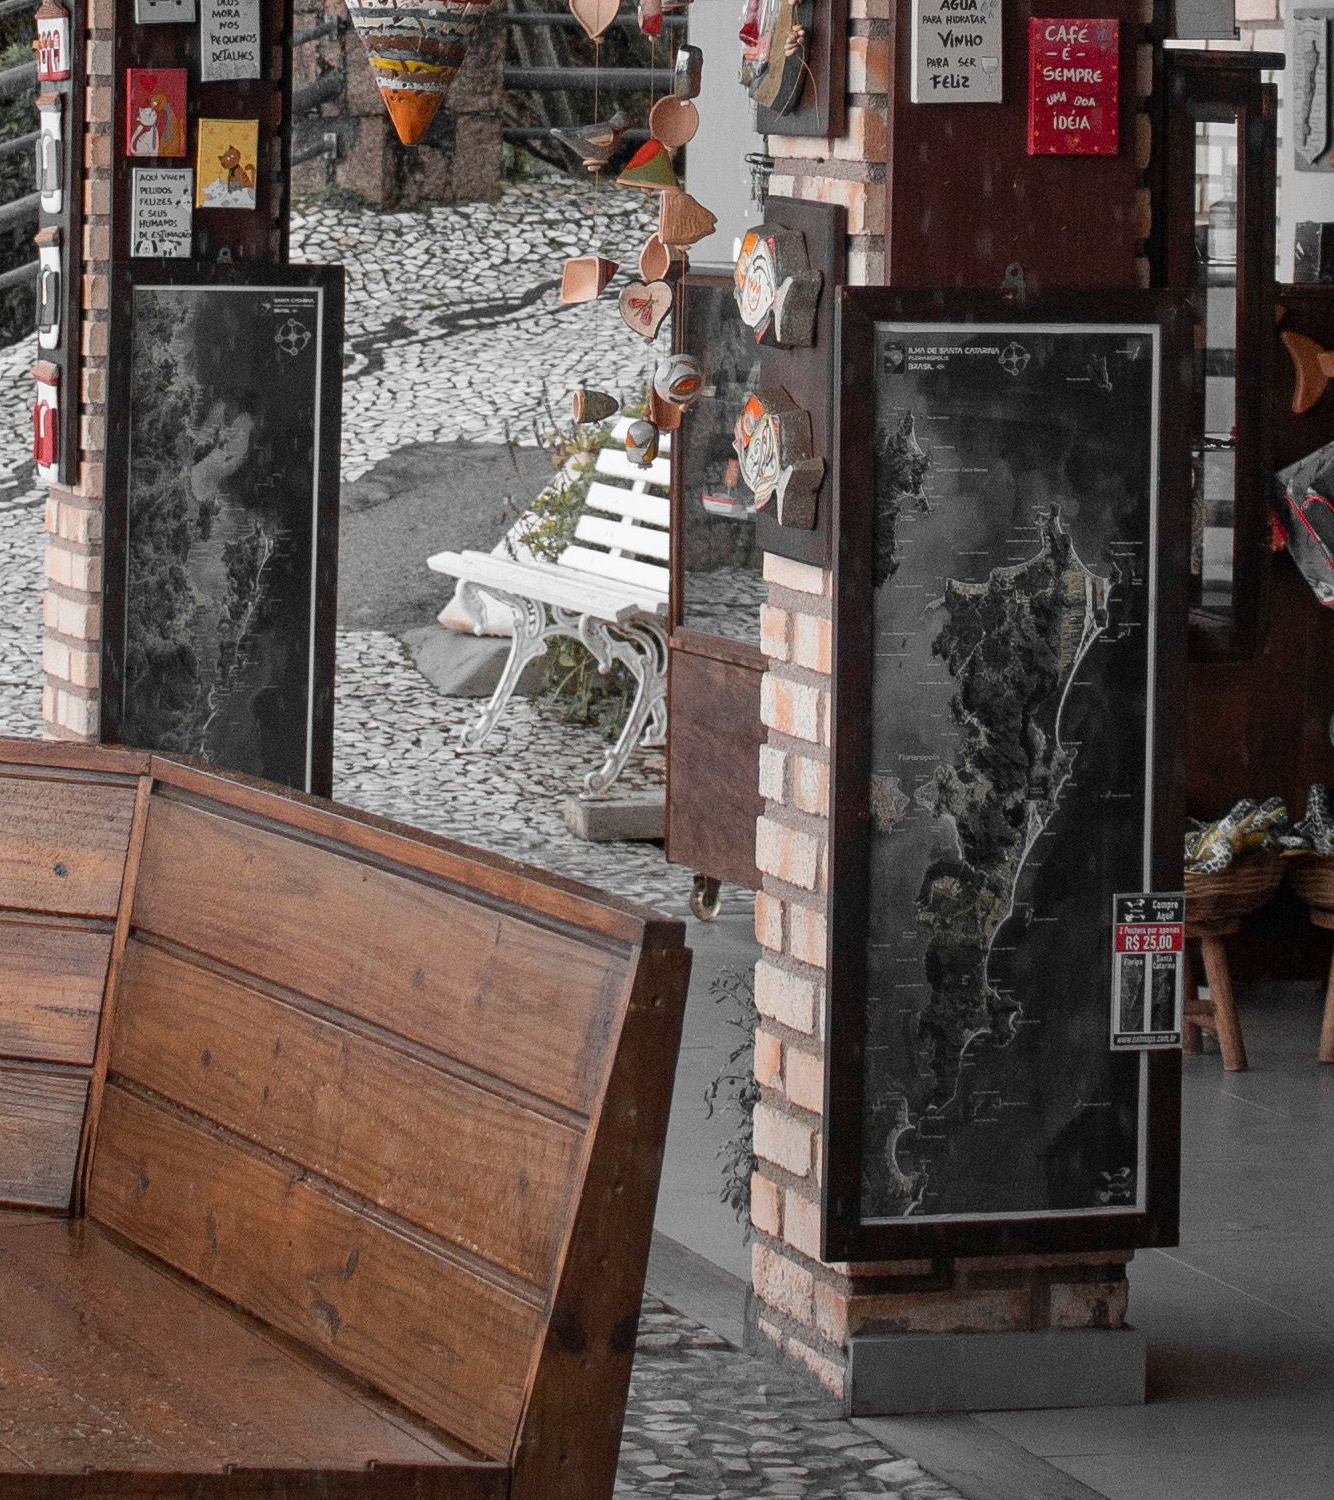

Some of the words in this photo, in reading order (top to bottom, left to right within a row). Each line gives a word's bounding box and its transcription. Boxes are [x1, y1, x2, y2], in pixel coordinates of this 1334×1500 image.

[211, 8, 240, 18] MORA
[922, 15, 943, 24] PARA
[219, 20, 240, 30] NOS
[210, 33, 257, 45] PEQUENOS
[211, 48, 255, 62] DETALHES
[926, 57, 949, 68] PARA
[957, 57, 977, 68] SER
[1042, 66, 1104, 83] SEMPRE
[1046, 91, 1067, 105] UMA
[1073, 95, 1096, 106] BOA
[139, 173, 158, 182] AQUI
[161, 173, 186, 181] VIVEM
[139, 186, 173, 195] PELUDOS
[139, 198, 173, 206] FELIZES
[139, 219, 178, 229] HUMANOS
[939, 347, 964, 355] SANTA
[964, 347, 1000, 355] CATARINA
[1152, 900, 1179, 911] Compre
[1119, 927, 1124, 935] 2
[1147, 927, 1158, 936] por
[1159, 926, 1180, 935] apenas
[1125, 935, 1140, 951] R$
[1143, 935, 1173, 952] 25,00
